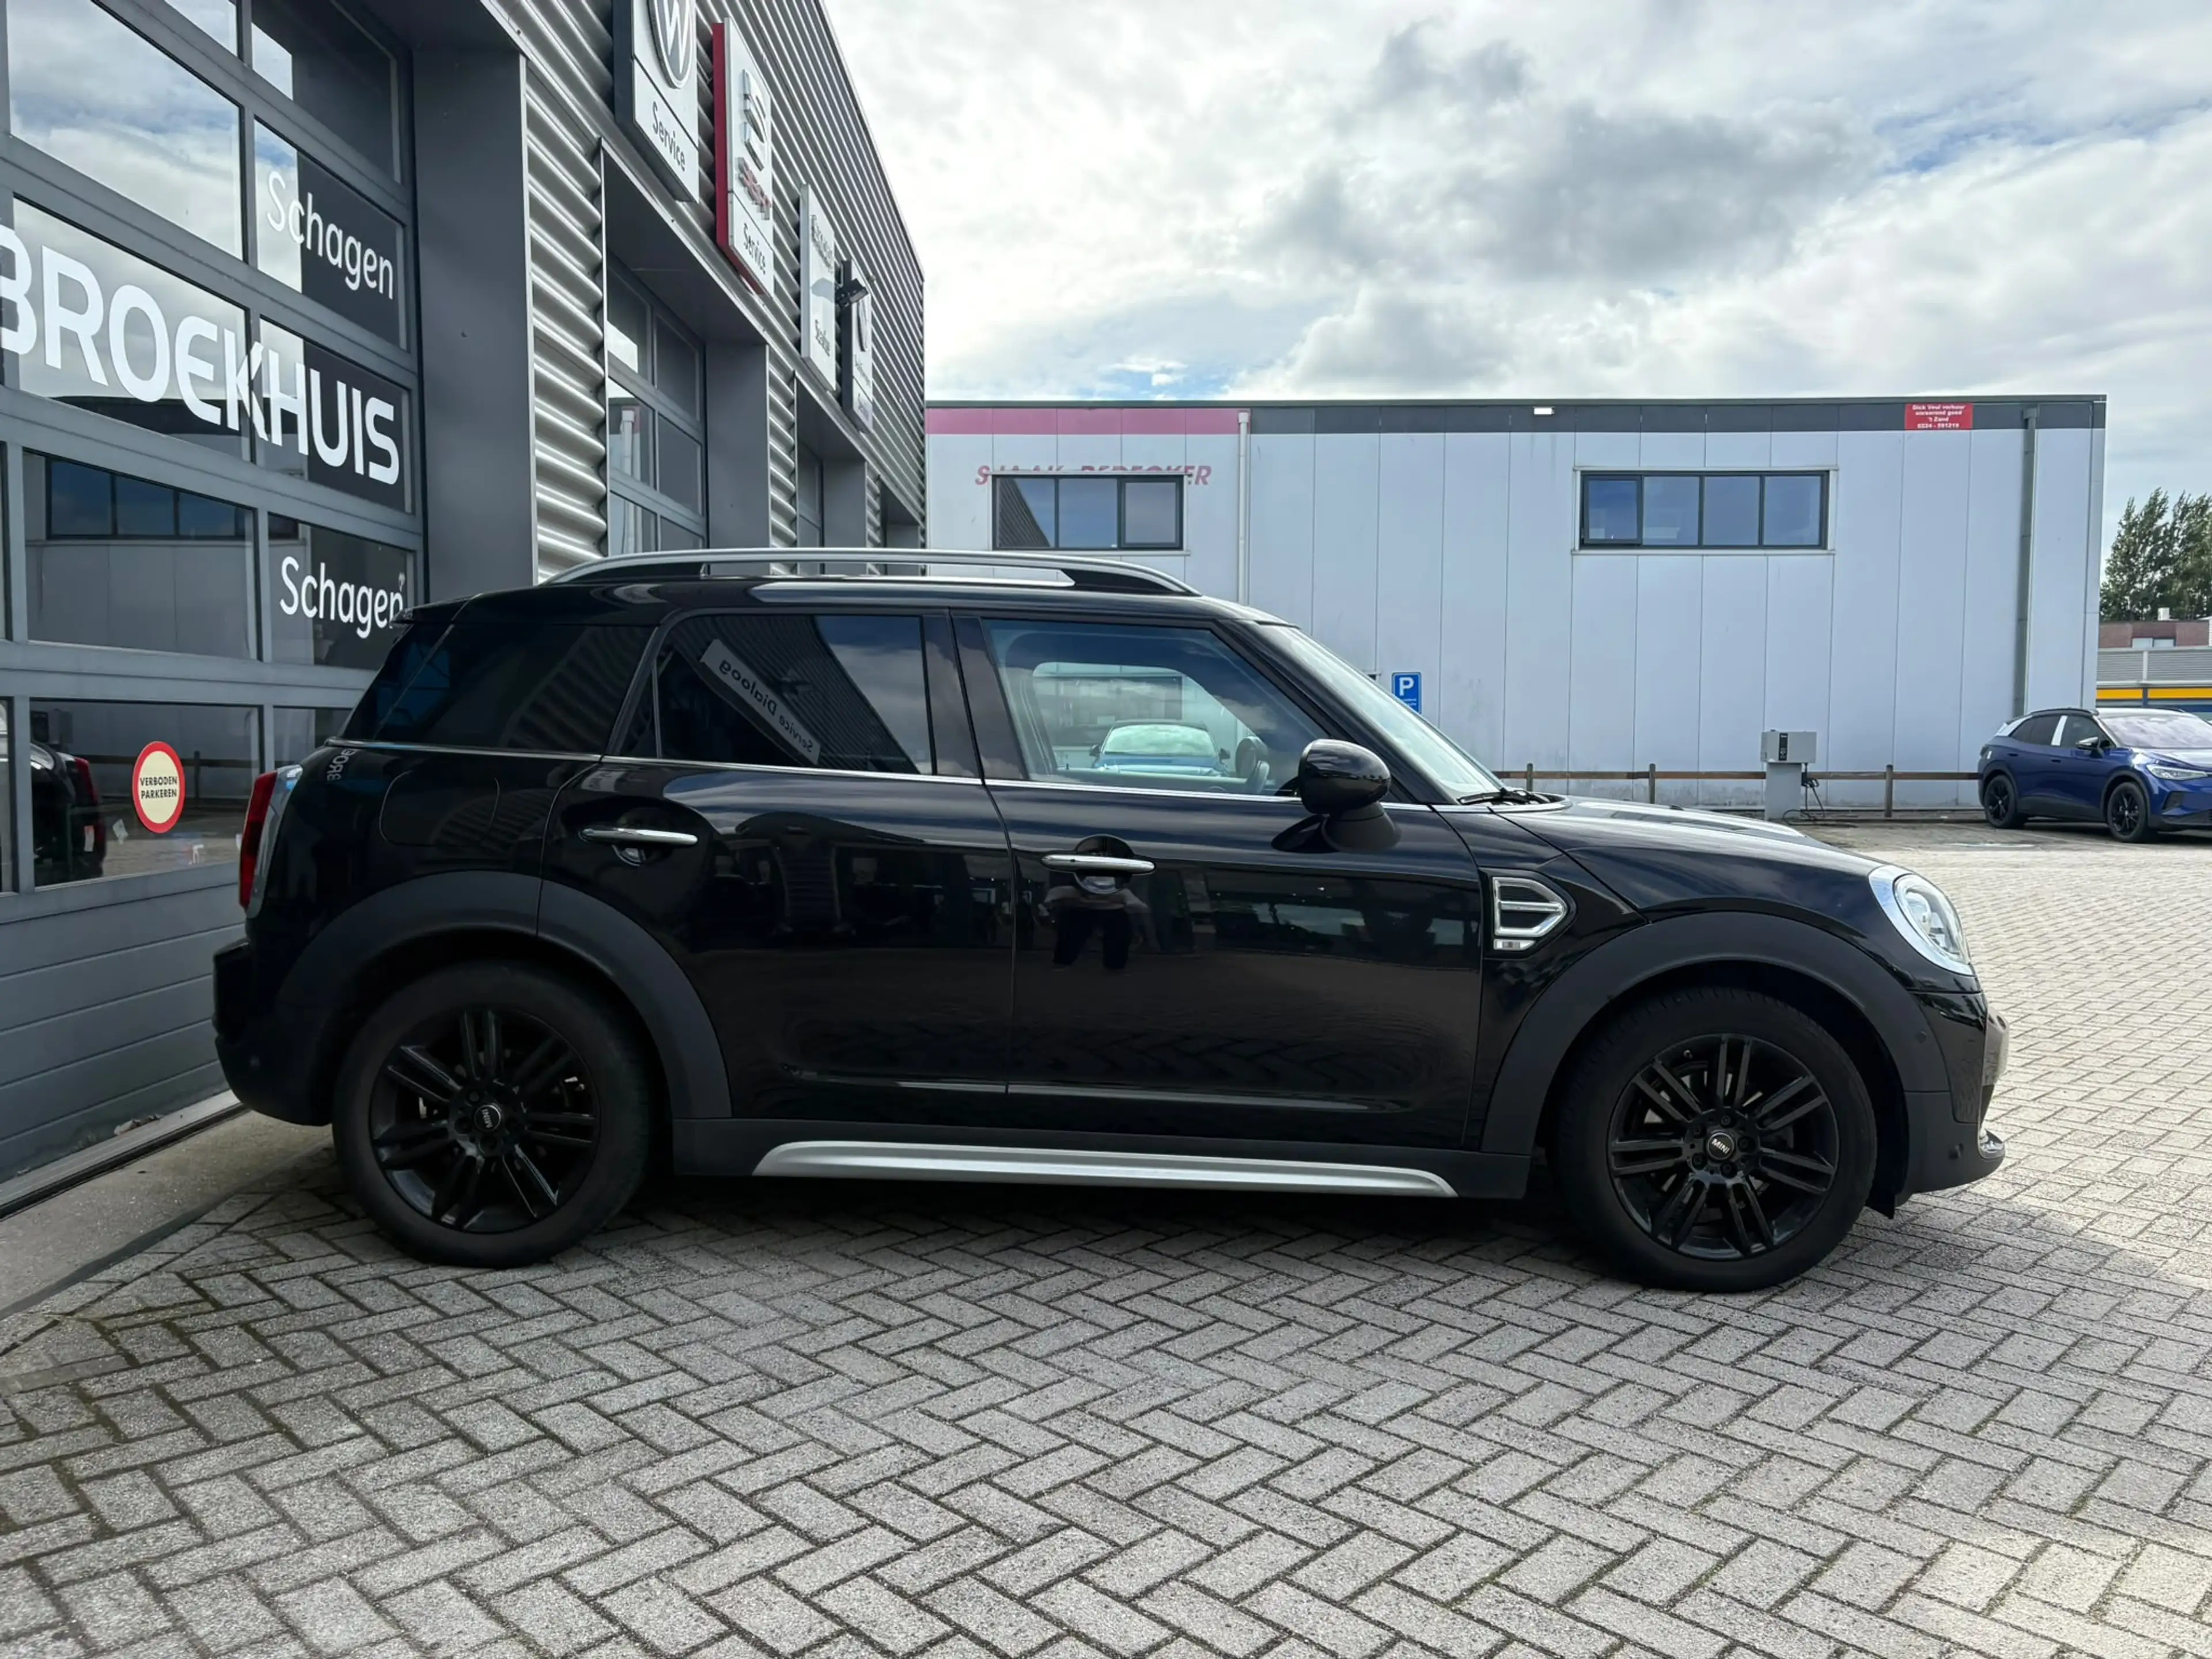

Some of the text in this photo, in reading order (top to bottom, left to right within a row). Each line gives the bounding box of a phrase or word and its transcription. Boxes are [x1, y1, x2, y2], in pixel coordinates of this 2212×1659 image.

[652, 100, 685, 172] Service
[267, 171, 393, 300] Schagen
[743, 222, 766, 275] Service
[279, 556, 403, 639] Schagen
[1399, 677, 1415, 696] P
[139, 776, 177, 786] VERBODEN
[141, 788, 177, 800] PARKEREN
[1711, 1138, 1730, 1154] MINI
